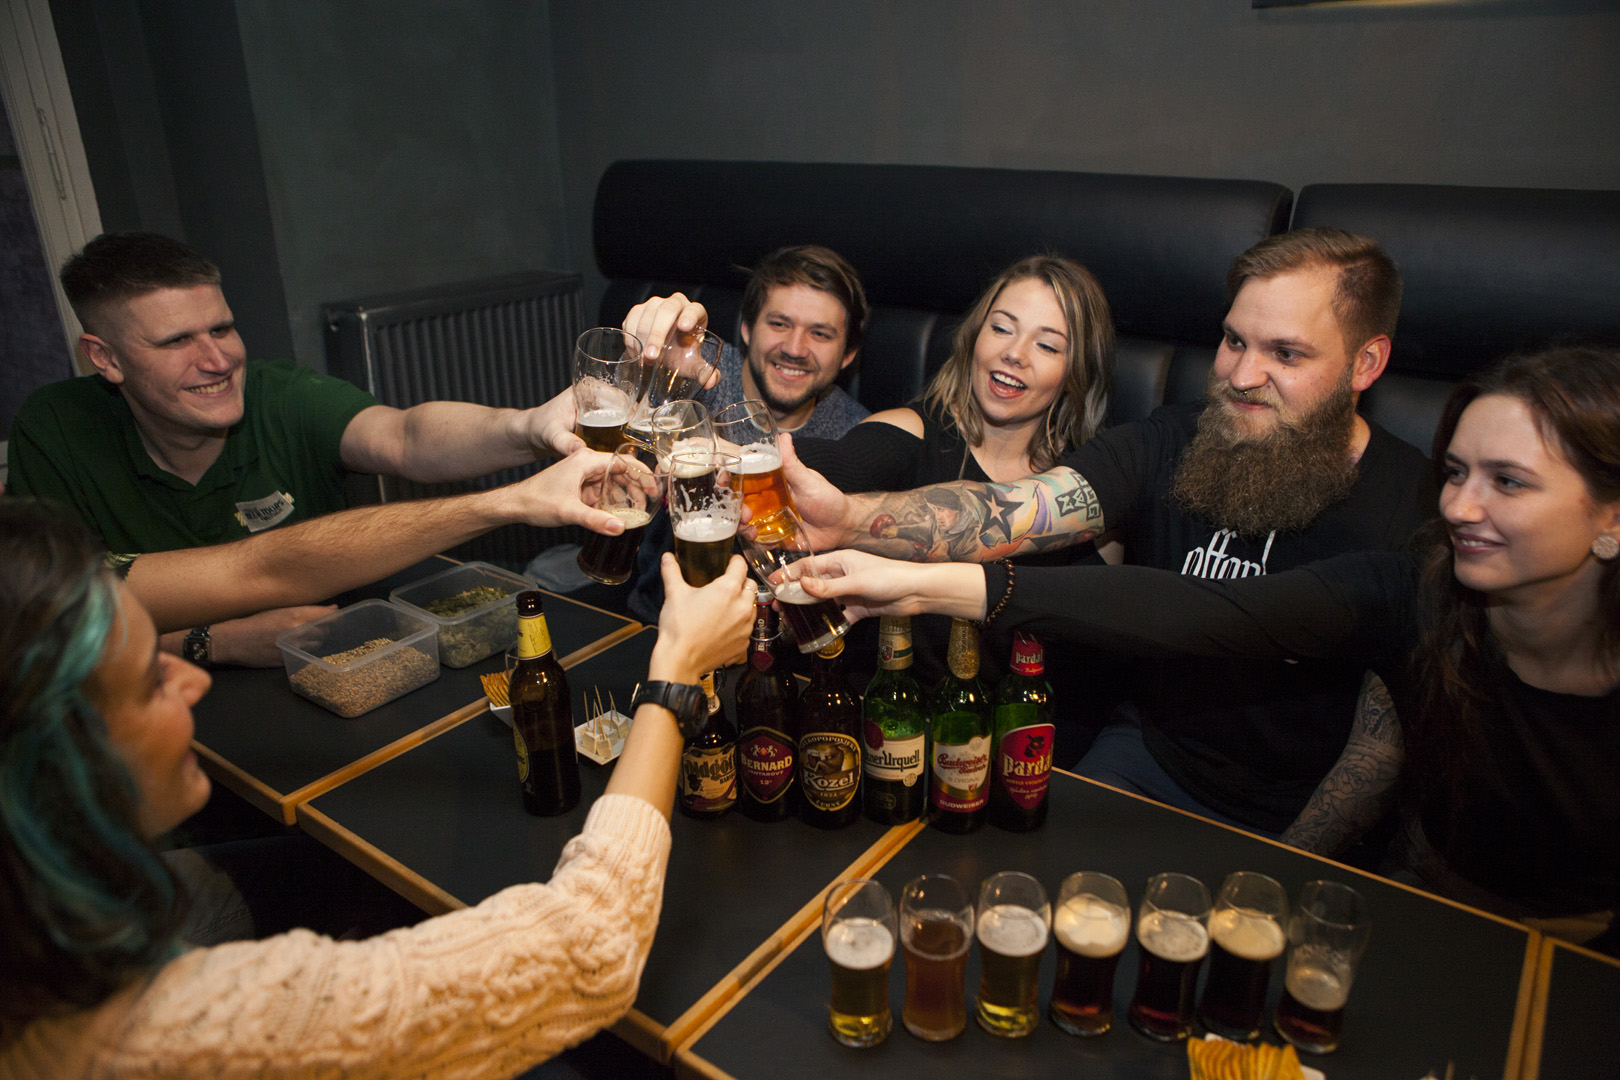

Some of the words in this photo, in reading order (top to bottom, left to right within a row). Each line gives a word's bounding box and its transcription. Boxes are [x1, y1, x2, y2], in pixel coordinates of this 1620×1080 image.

[741, 753, 793, 772] BERNARD
[882, 749, 920, 772] Urquell
[803, 769, 855, 791] Kozel
[939, 799, 985, 809] BUDWEISER
